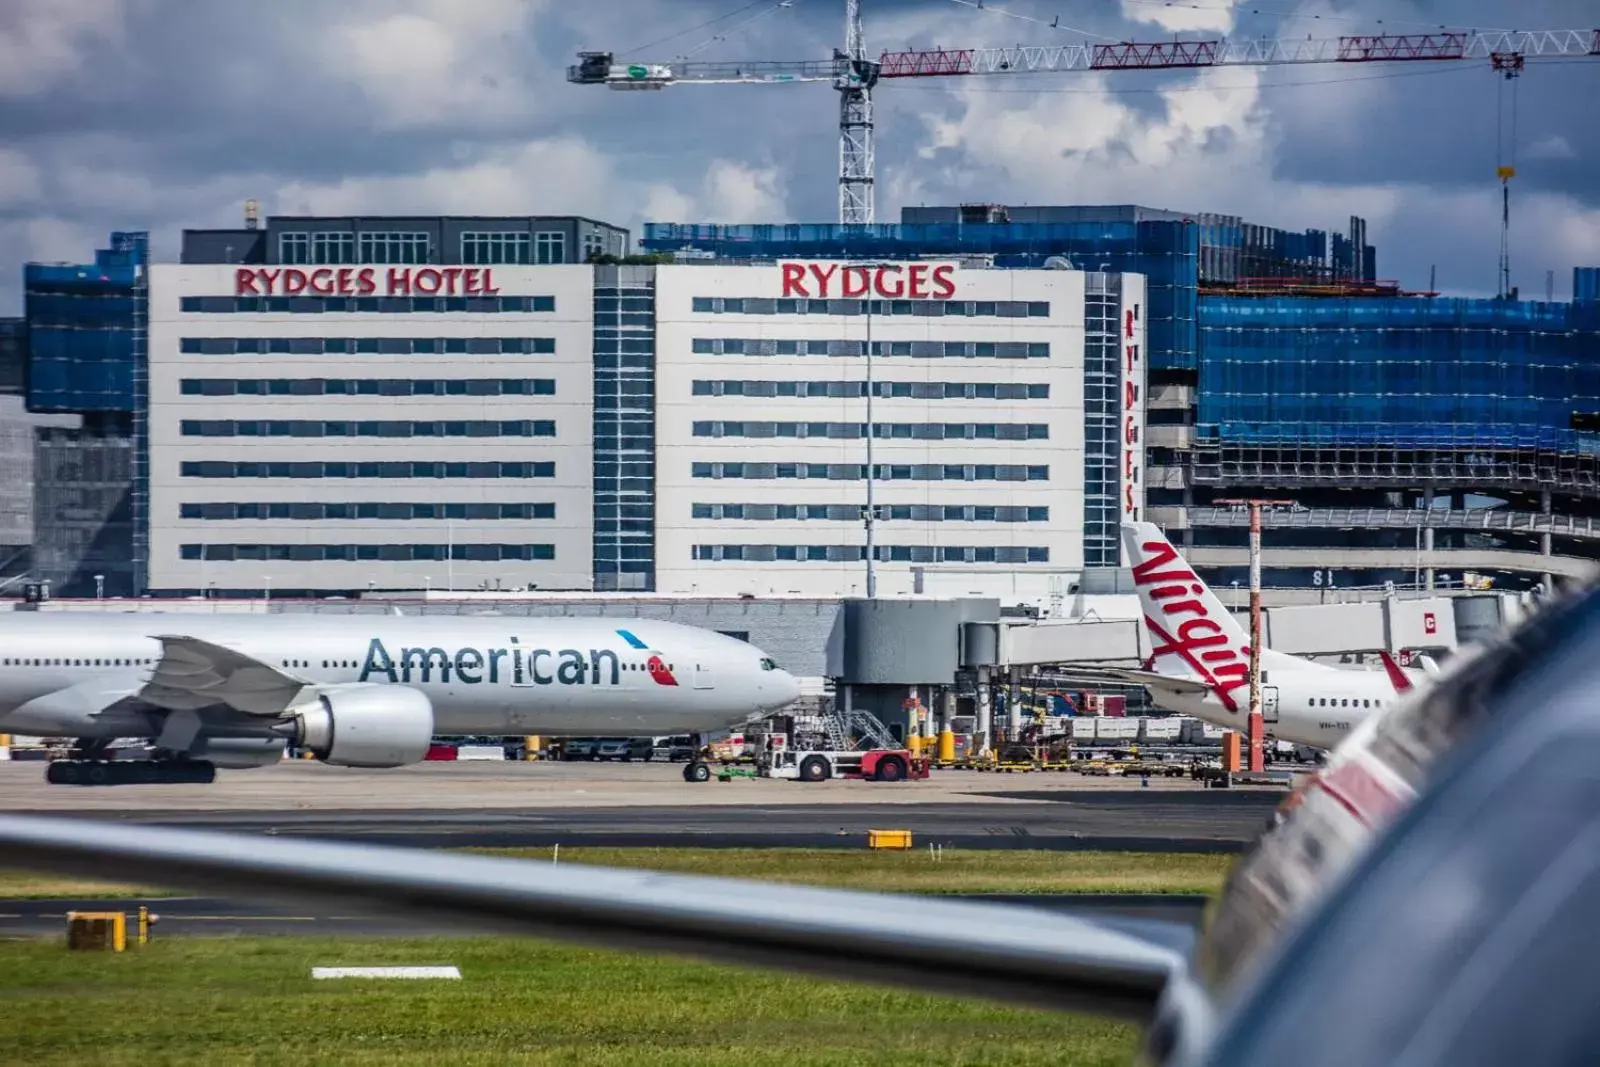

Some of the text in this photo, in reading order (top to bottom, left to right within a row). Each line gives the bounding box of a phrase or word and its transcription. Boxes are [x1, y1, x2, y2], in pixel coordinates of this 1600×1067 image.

[235, 268, 500, 296] RYDGES HOTEL
[782, 263, 956, 299] RYDGES
[1125, 309, 1134, 514] RYDGES
[1131, 541, 1250, 713] Virgin
[357, 636, 621, 685] American
